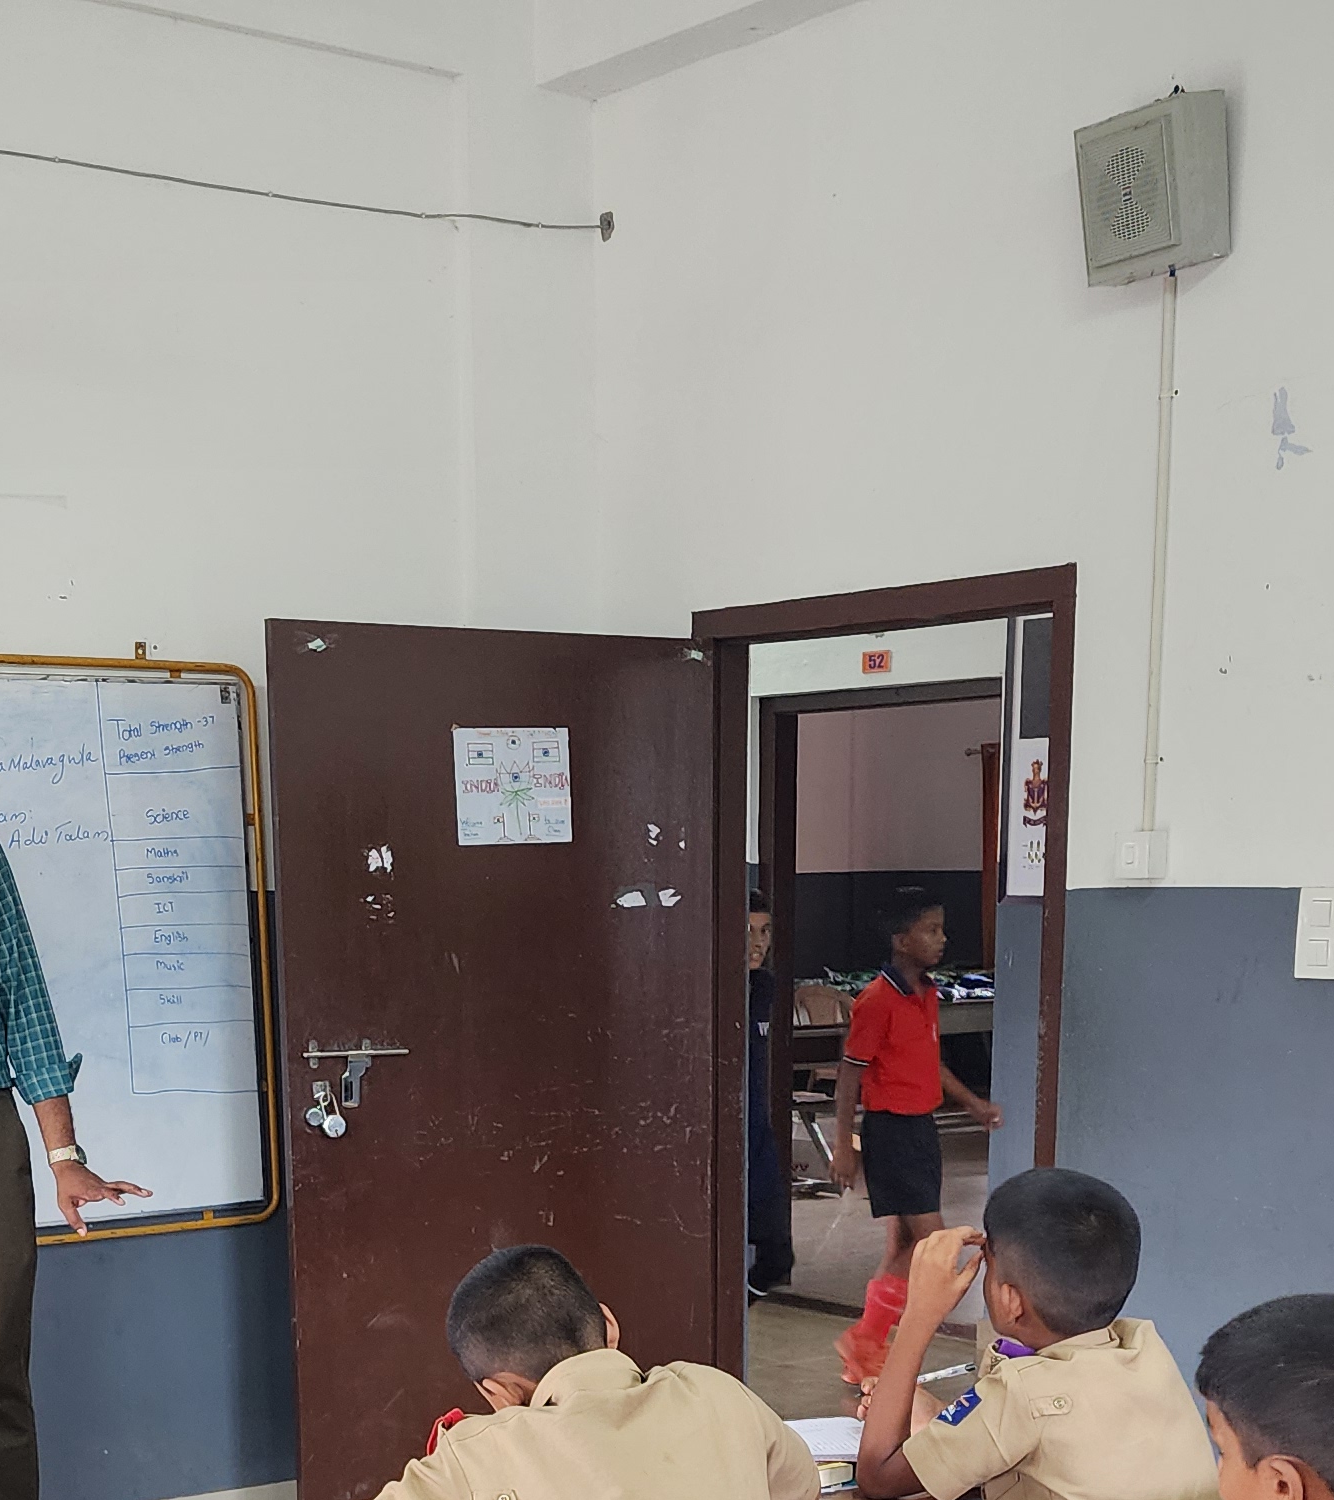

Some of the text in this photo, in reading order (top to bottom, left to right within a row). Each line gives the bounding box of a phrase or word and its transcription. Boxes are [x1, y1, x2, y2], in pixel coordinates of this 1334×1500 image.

[868, 653, 885, 669] 52
[106, 719, 142, 741] Total
[149, 718, 193, 736] Strength
[118, 748, 157, 766] Present
[145, 808, 190, 825] Science
[55, 820, 109, 844] Talam
[146, 847, 179, 859] Maths
[146, 870, 189, 884] Sanskrit
[154, 901, 174, 914] ICT
[153, 929, 189, 946] English
[156, 960, 185, 971] Music
[159, 993, 182, 1005] Skill
